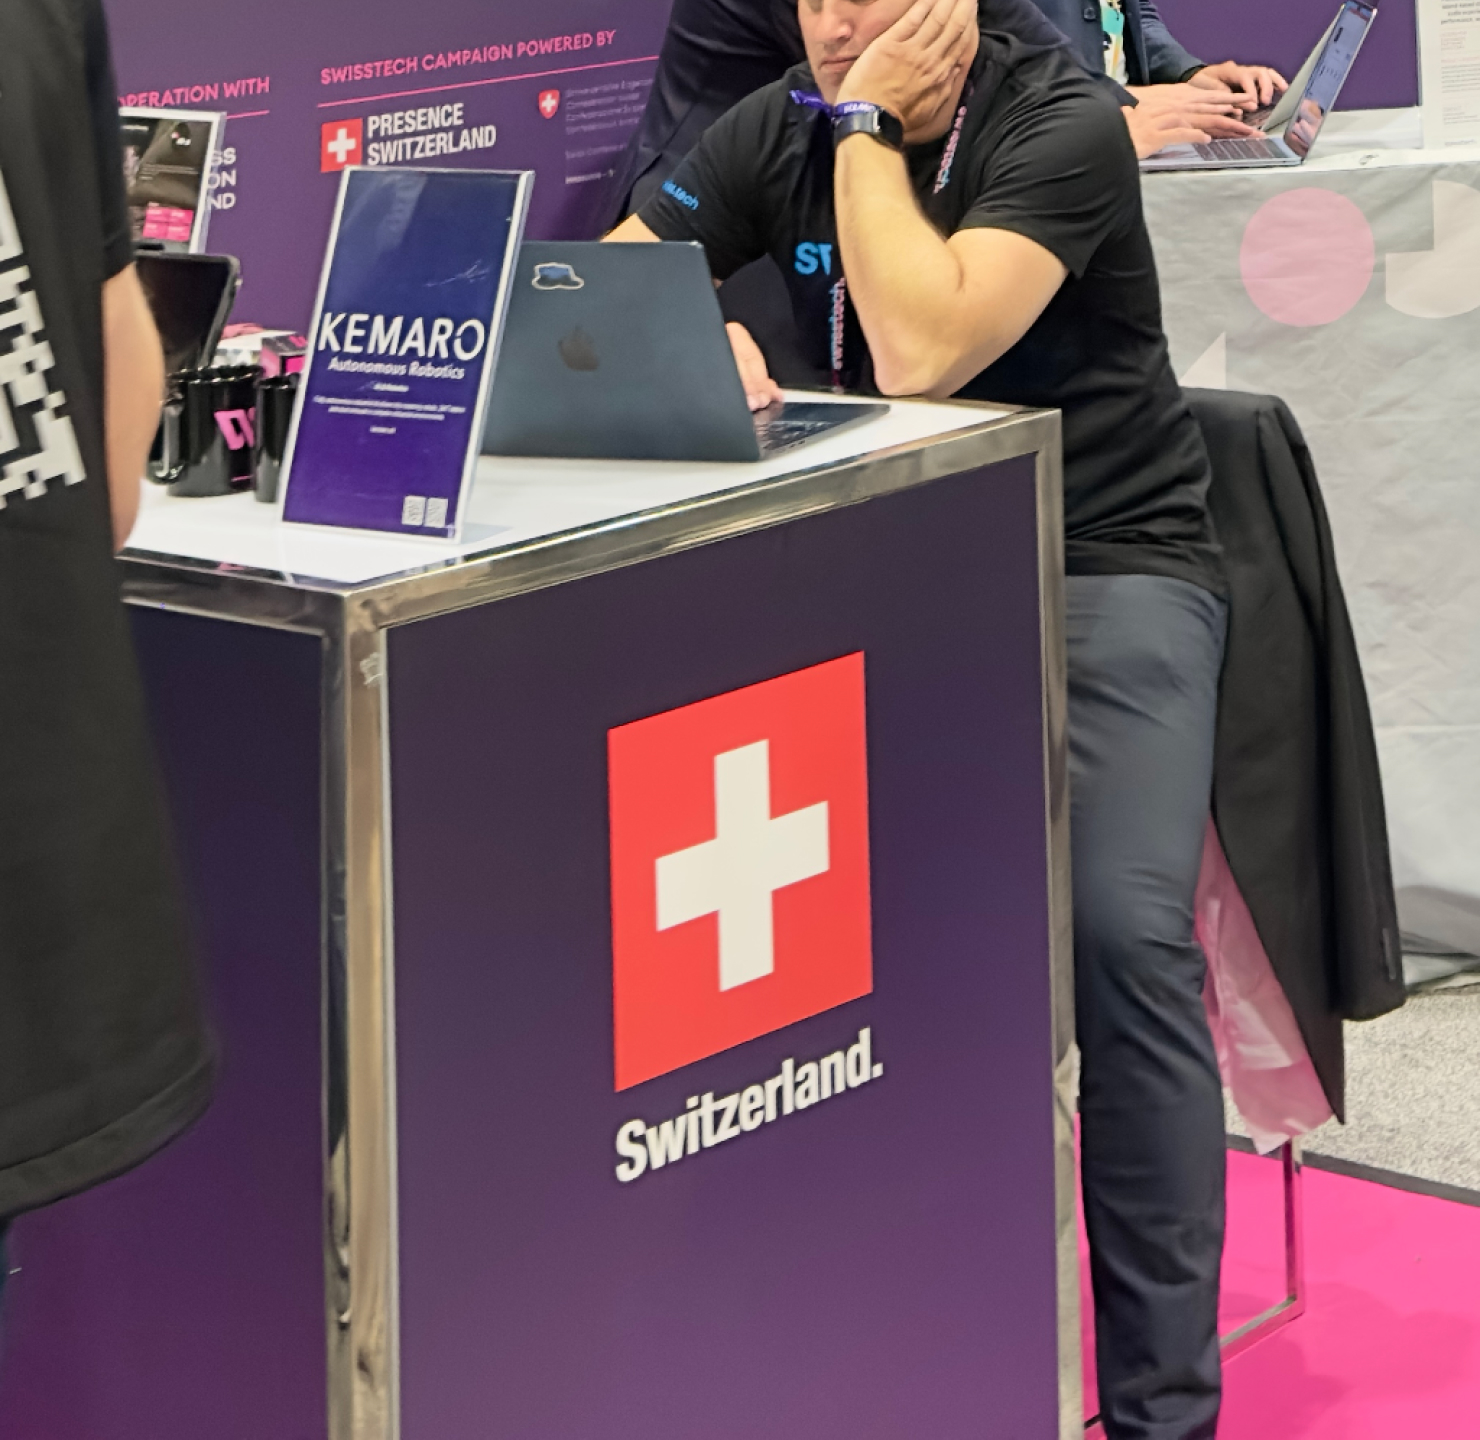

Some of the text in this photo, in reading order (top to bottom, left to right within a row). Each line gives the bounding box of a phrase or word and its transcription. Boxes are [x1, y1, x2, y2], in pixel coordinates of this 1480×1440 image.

[321, 29, 616, 85] SWISSTECH CAMPAIGN POWERED BY
[223, 77, 270, 98] WITH
[368, 103, 464, 138] PRESENCE
[368, 125, 496, 165] SWITZERLAND
[318, 312, 485, 361] KEMARO
[328, 356, 465, 379] Autonomous Robotics
[616, 1027, 883, 1183] Switzerland.
